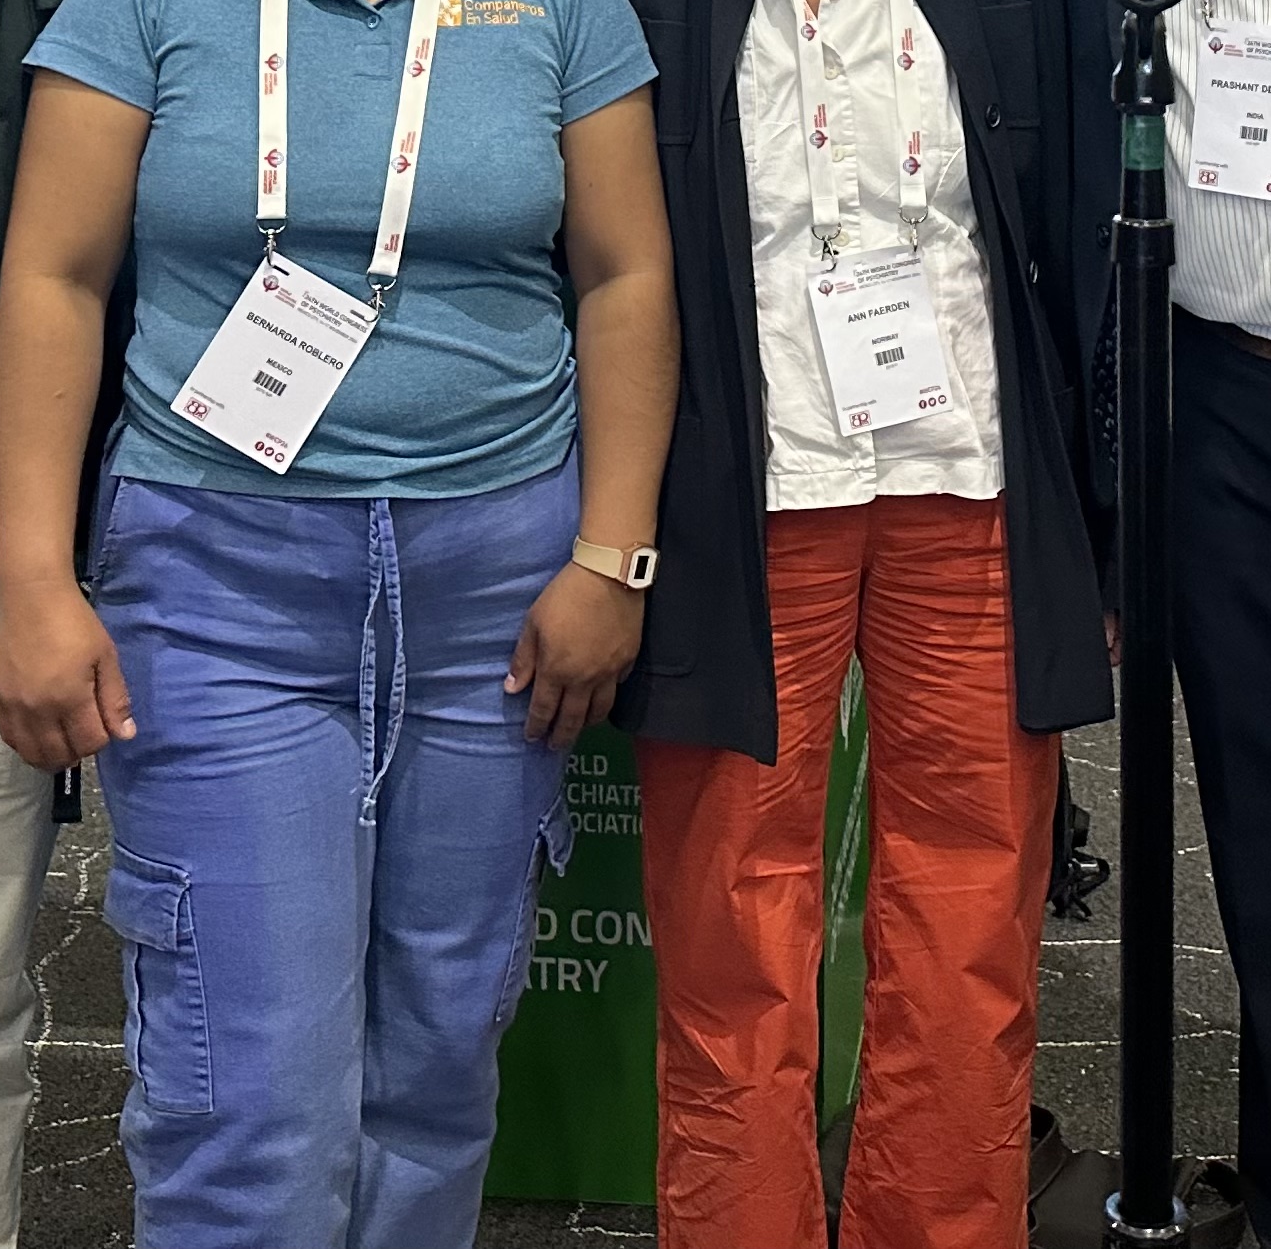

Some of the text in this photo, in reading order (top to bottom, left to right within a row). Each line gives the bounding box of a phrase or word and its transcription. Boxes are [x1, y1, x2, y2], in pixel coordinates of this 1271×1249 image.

[483, 11, 519, 25] Salud
[1211, 79, 1259, 94] PRASHANT
[847, 301, 910, 324] ANN FAERDEN
[246, 311, 298, 347] BERNARDA
[298, 340, 344, 371] ROBLERO
[266, 357, 293, 376] MEXICO
[566, 754, 609, 776] RLD
